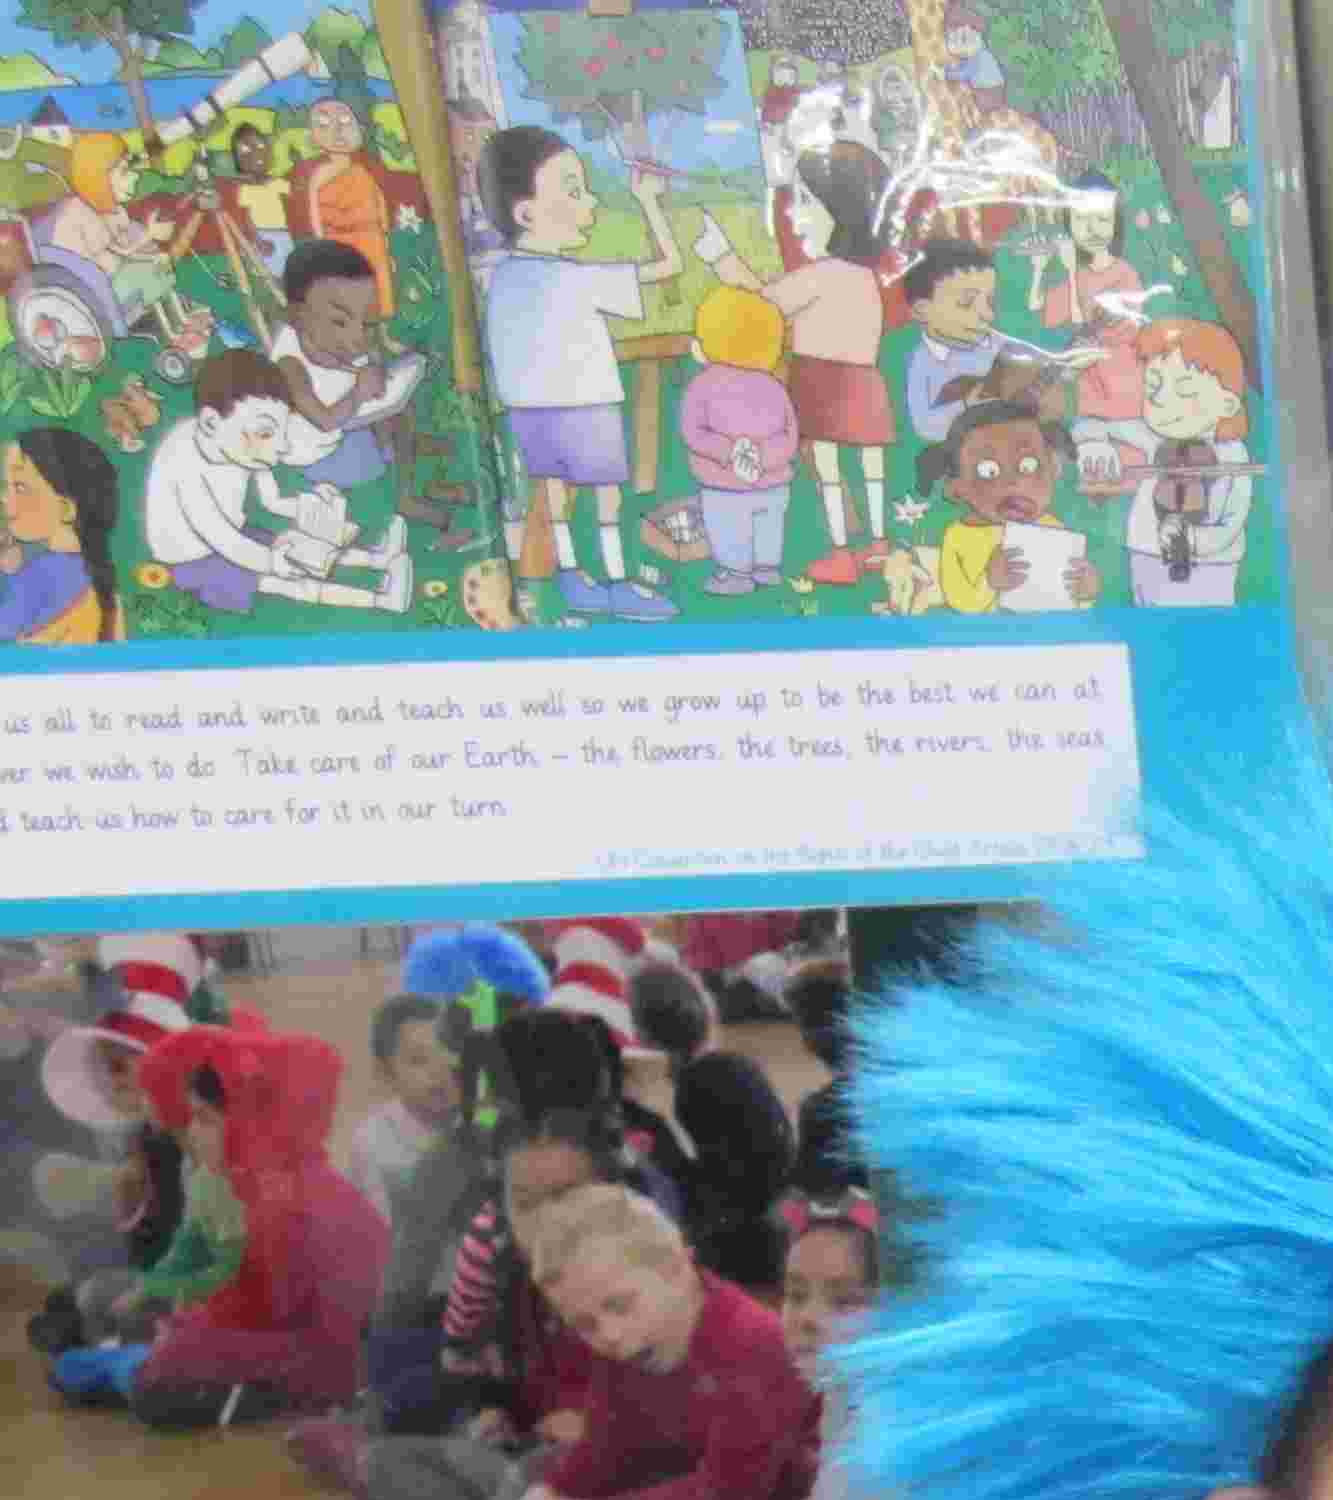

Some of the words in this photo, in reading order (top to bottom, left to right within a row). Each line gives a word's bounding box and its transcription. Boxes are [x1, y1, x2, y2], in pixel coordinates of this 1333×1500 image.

[4, 711, 32, 736] us
[44, 704, 77, 733] all
[88, 706, 112, 732] to
[121, 703, 183, 730] read
[197, 700, 249, 729] and
[258, 703, 320, 727] write
[336, 696, 384, 723] and
[394, 696, 464, 721] teach
[481, 702, 508, 720] us
[521, 688, 567, 718] well
[579, 697, 606, 717] so
[617, 696, 649, 714] we
[663, 695, 721, 726] grow
[736, 693, 767, 721] up
[780, 688, 804, 710] to
[816, 680, 843, 709] be
[857, 680, 896, 707] the
[908, 678, 955, 705] best
[967, 681, 1000, 703] we
[1014, 680, 1057, 702] can
[1073, 673, 1103, 701] at
[44, 763, 78, 783] we
[84, 752, 143, 782] wish
[149, 756, 175, 781] to
[235, 746, 298, 776] Take
[310, 755, 360, 775] care
[374, 744, 397, 772] of
[409, 753, 454, 770] our
[463, 739, 540, 768] Earth
[579, 736, 621, 765] the
[737, 730, 777, 759] the
[863, 728, 904, 756] the
[1005, 721, 1046, 752] the
[19, 802, 85, 832] teach
[95, 808, 121, 830] us
[129, 800, 180, 829] how
[190, 800, 213, 827] to
[223, 806, 276, 826] care
[284, 794, 320, 826] for
[331, 799, 353, 824] it
[360, 801, 385, 822] in
[398, 801, 438, 820] our
